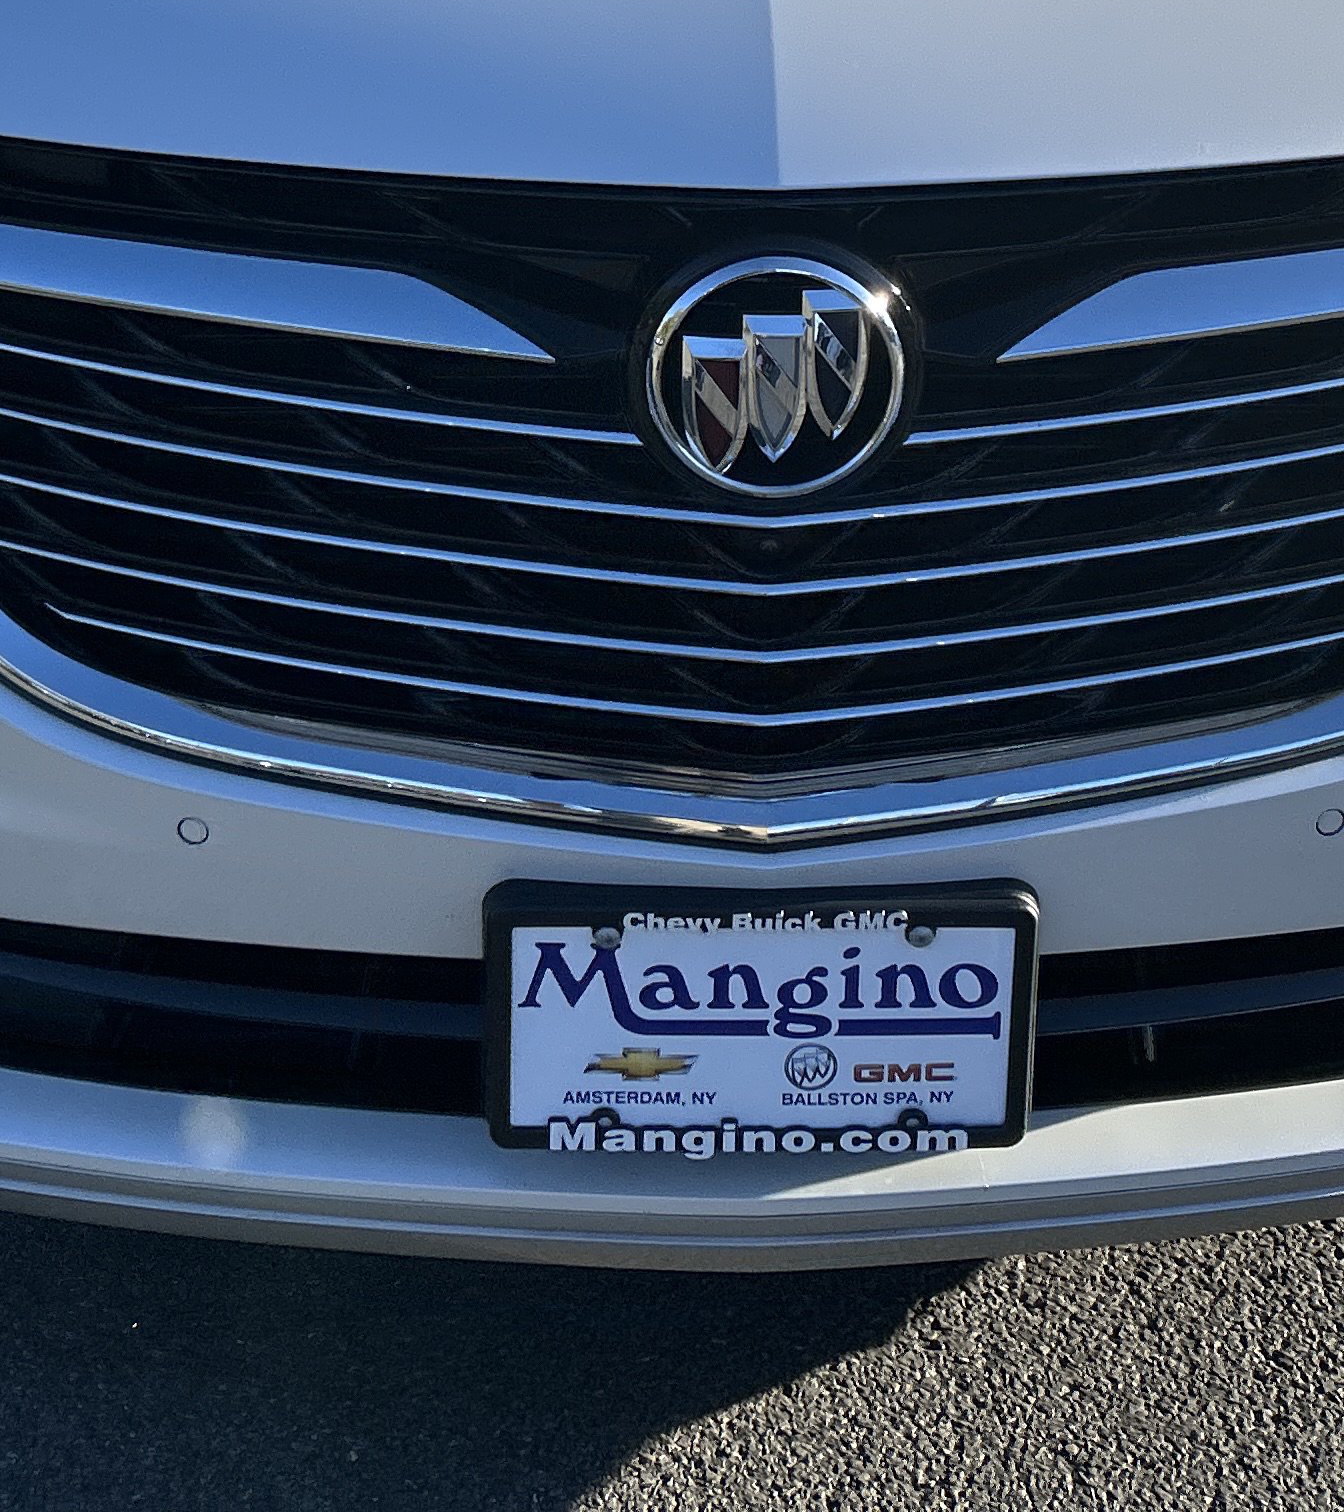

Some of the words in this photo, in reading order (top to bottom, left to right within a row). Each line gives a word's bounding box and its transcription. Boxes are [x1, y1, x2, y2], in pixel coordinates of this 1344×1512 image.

[623, 912, 721, 936] Chevy
[732, 910, 822, 932] Buick
[834, 909, 909, 931] GMC
[518, 942, 1001, 1040] Mangino
[853, 1062, 956, 1083] GMC
[563, 1091, 687, 1106] AMSTERDAM,
[692, 1091, 717, 1104] NY
[782, 1092, 877, 1106] BALLSTON
[883, 1092, 923, 1106] SPA,
[930, 1091, 955, 1104] NY
[549, 1120, 968, 1160] Mangino.com
